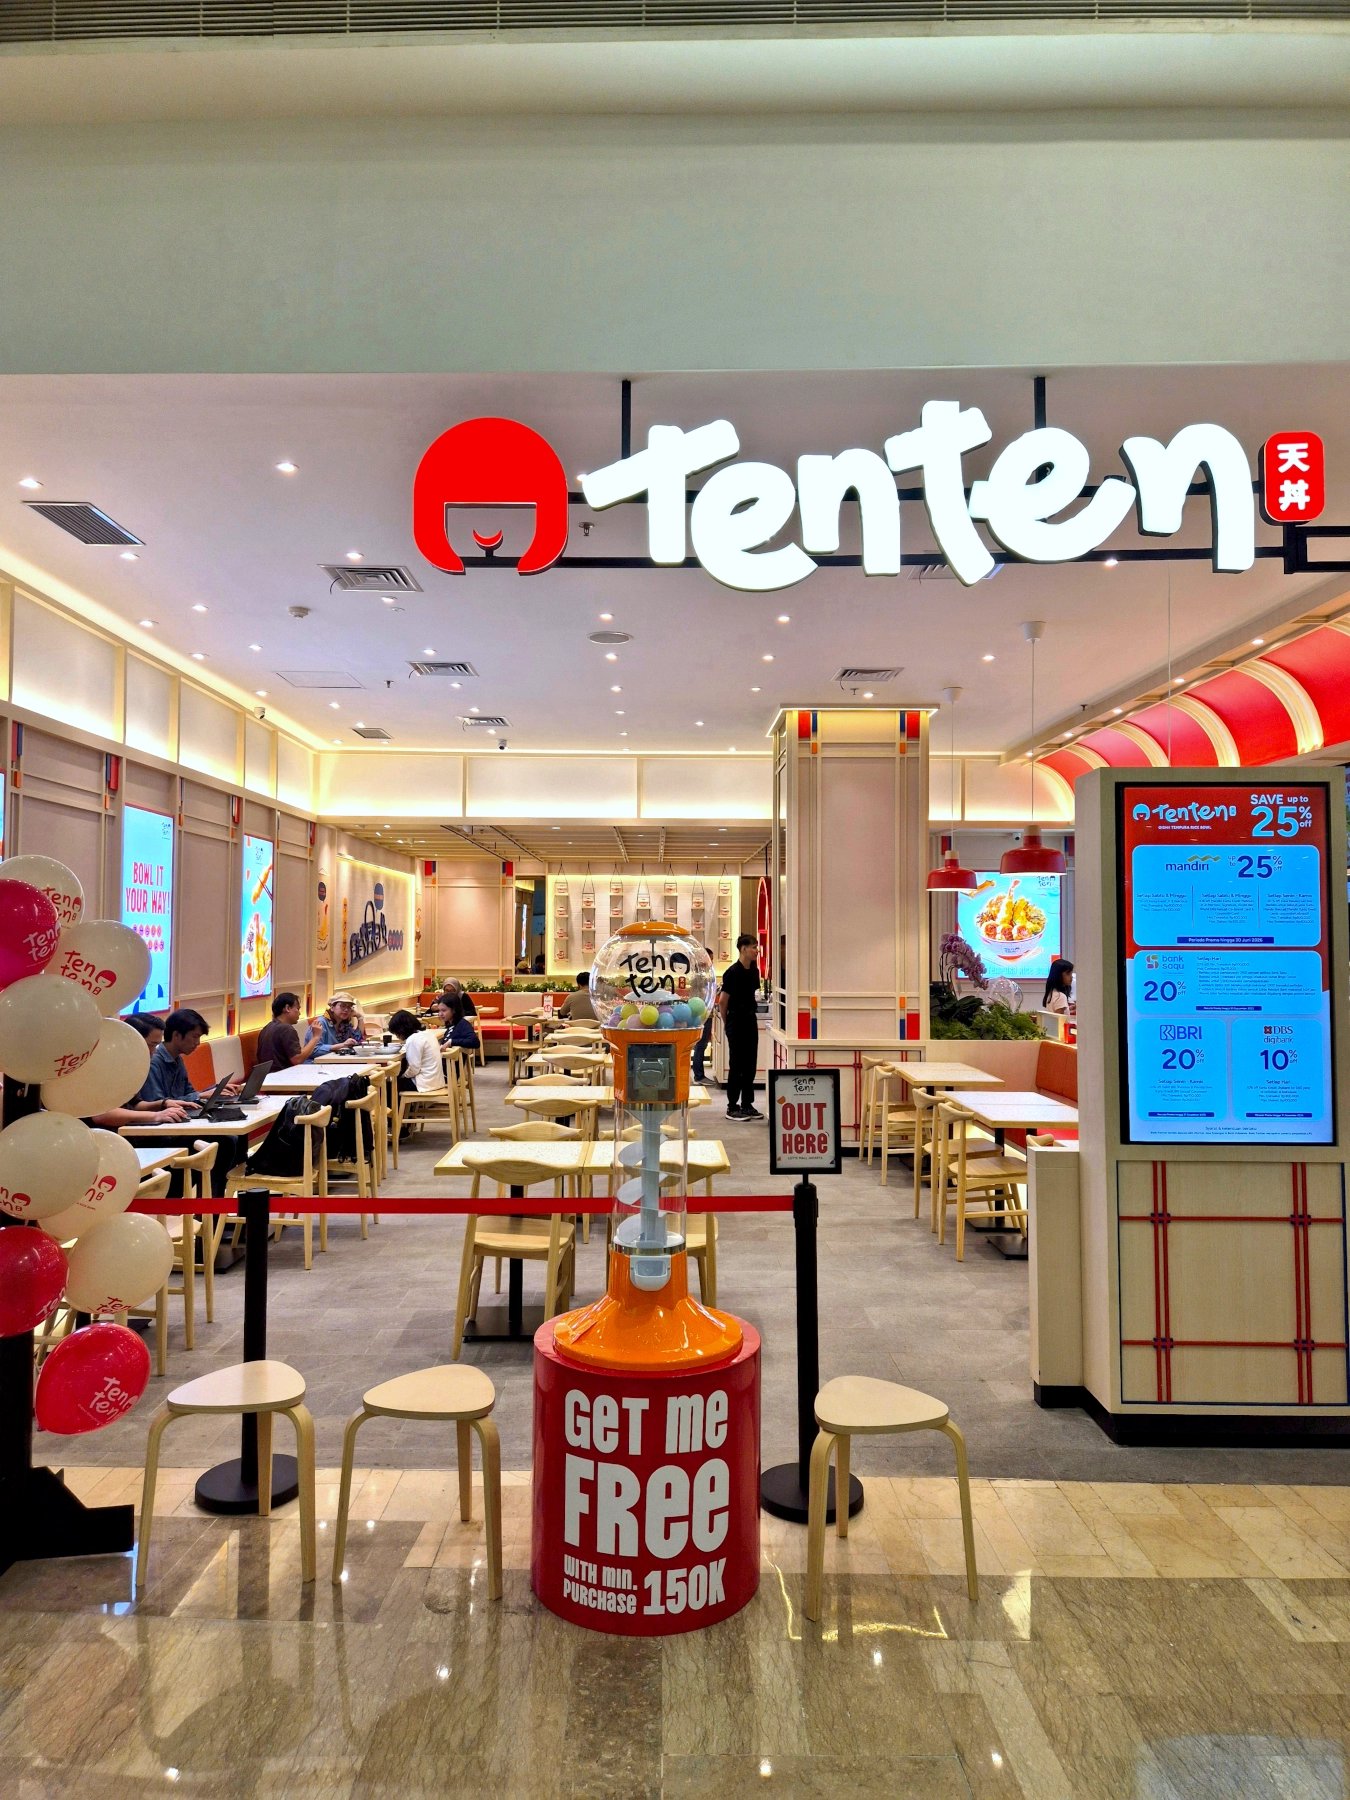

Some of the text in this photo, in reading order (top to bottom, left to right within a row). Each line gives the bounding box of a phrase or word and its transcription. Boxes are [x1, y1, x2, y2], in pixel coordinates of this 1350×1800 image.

[582, 400, 1255, 591] Tenten
[1152, 801, 1229, 823] Tenten
[1250, 794, 1283, 805] SAVE
[1299, 795, 1309, 803] to
[1299, 819, 1312, 828] off
[132, 861, 164, 887] BOWL IT
[1165, 861, 1209, 871] mandiri
[125, 887, 171, 915] YOUR WAY!
[23, 928, 55, 946] Ten
[65, 951, 96, 978] Ten
[619, 952, 666, 973] Ten
[625, 973, 675, 998] ten
[1177, 1025, 1203, 1040] BRI
[1263, 1035, 1294, 1045] digibank
[1273, 1026, 1294, 1034] DBS
[781, 1102, 827, 1131] OUT
[103, 1376, 129, 1406] Ten
[665, 1389, 729, 1455] me
[563, 1553, 638, 1591] WITH min.
[643, 1557, 727, 1616] 150K
